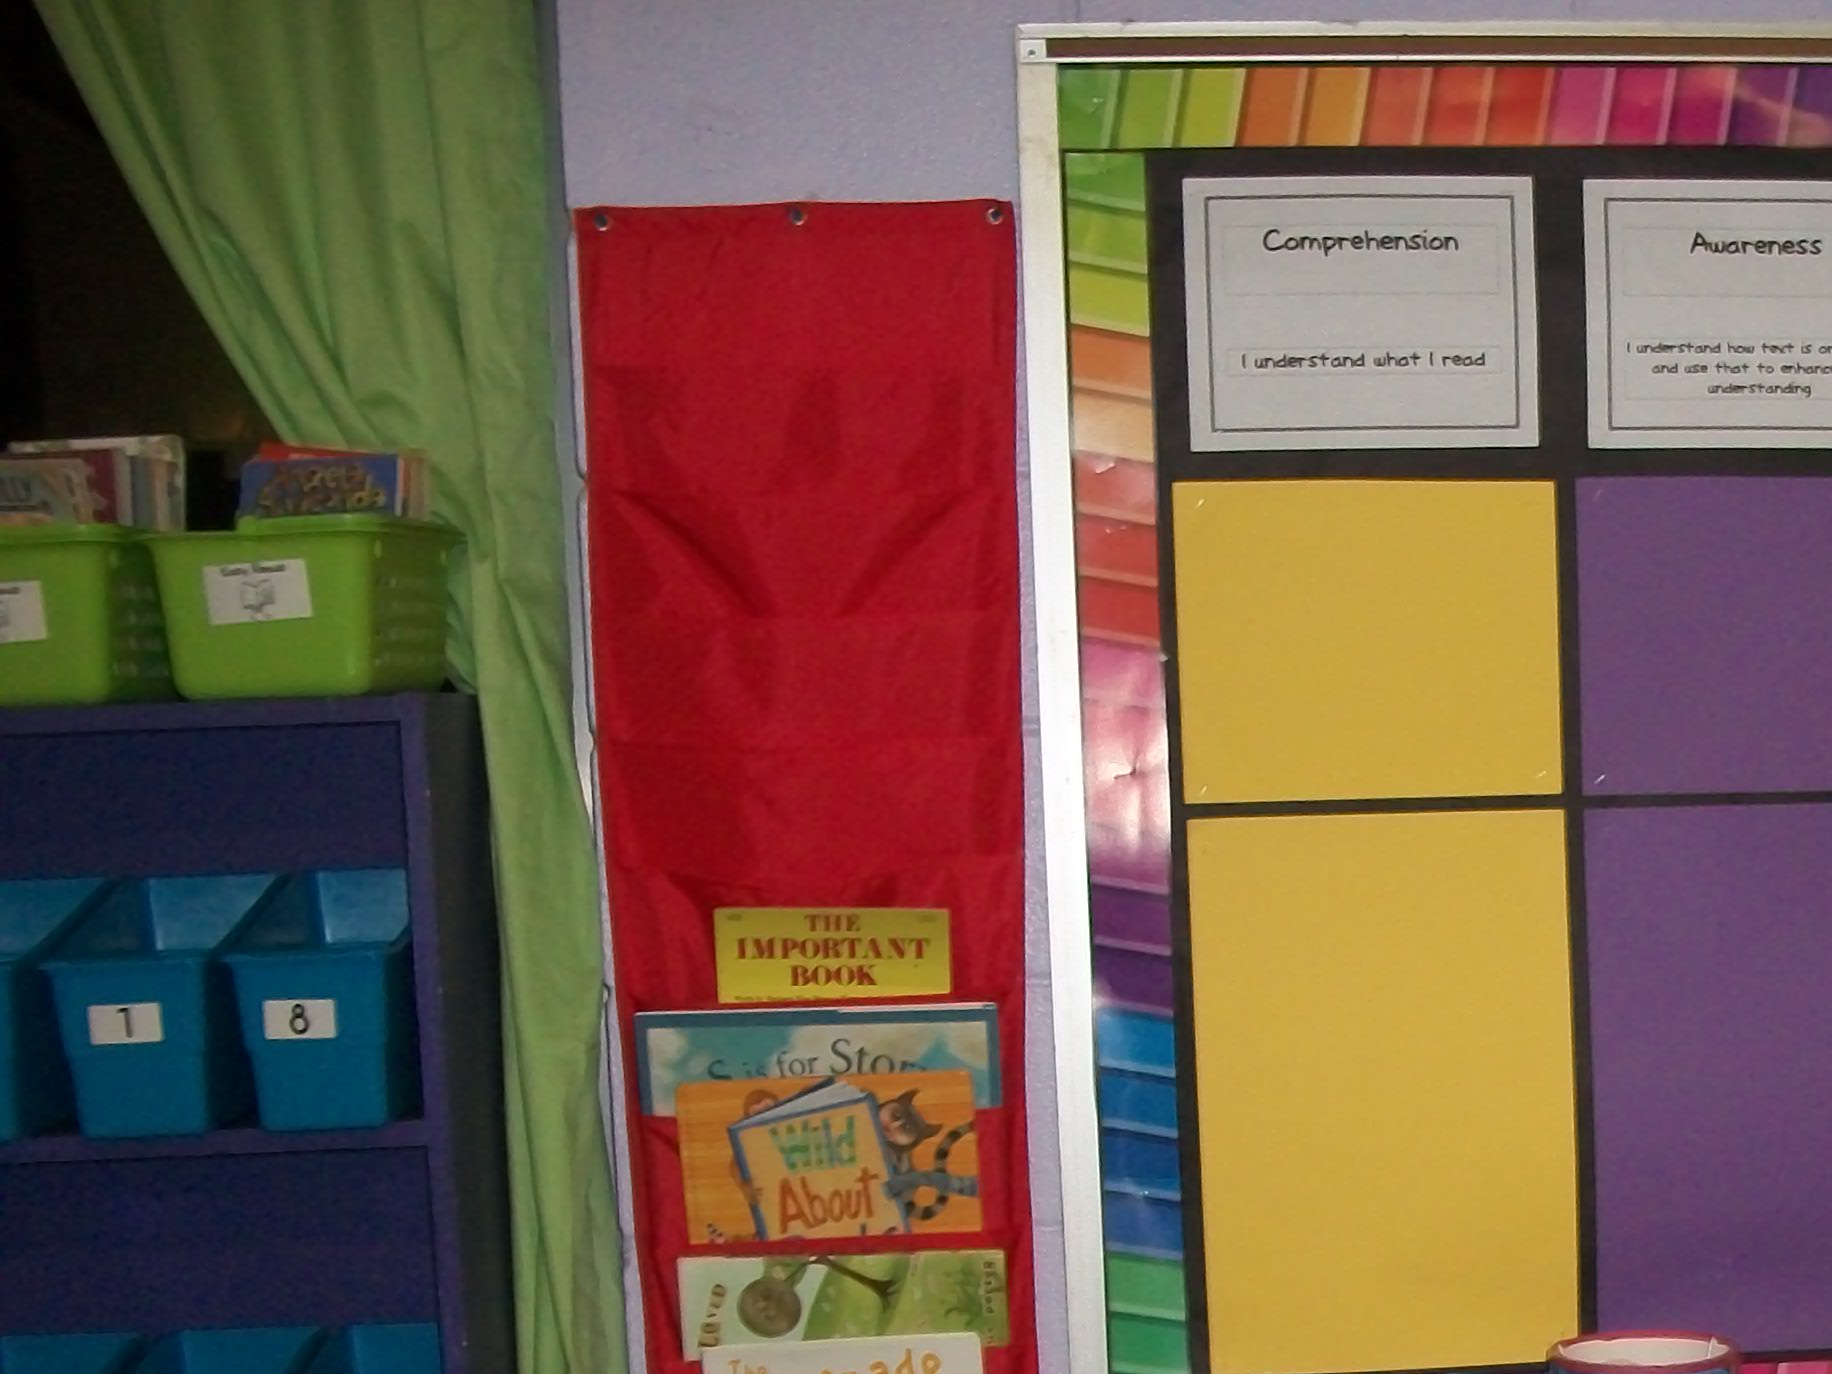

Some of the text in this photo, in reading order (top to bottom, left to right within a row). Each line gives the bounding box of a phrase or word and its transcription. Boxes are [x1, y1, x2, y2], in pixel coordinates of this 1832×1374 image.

[1263, 229, 1459, 256] Comprehension
[1689, 231, 1823, 256] Awareness
[1254, 353, 1365, 369] understand
[1373, 352, 1420, 367] what
[1442, 352, 1486, 367] read
[1636, 342, 1721, 355] understand
[1727, 342, 1754, 354] how
[1761, 342, 1795, 354] text
[1801, 342, 1812, 354] is
[1652, 363, 1678, 375] and
[1684, 364, 1708, 374] use
[1715, 362, 1750, 374] that
[1757, 363, 1774, 374] to
[1707, 382, 1812, 397] understanding
[804, 913, 861, 933] THE
[736, 937, 930, 960] IMPORTANT
[790, 963, 877, 987] BOOK
[288, 1003, 310, 1035] 8
[776, 1050, 818, 1077] for
[830, 1038, 927, 1075] Stor
[768, 1114, 857, 1174] Wild
[778, 1166, 879, 1234] About
